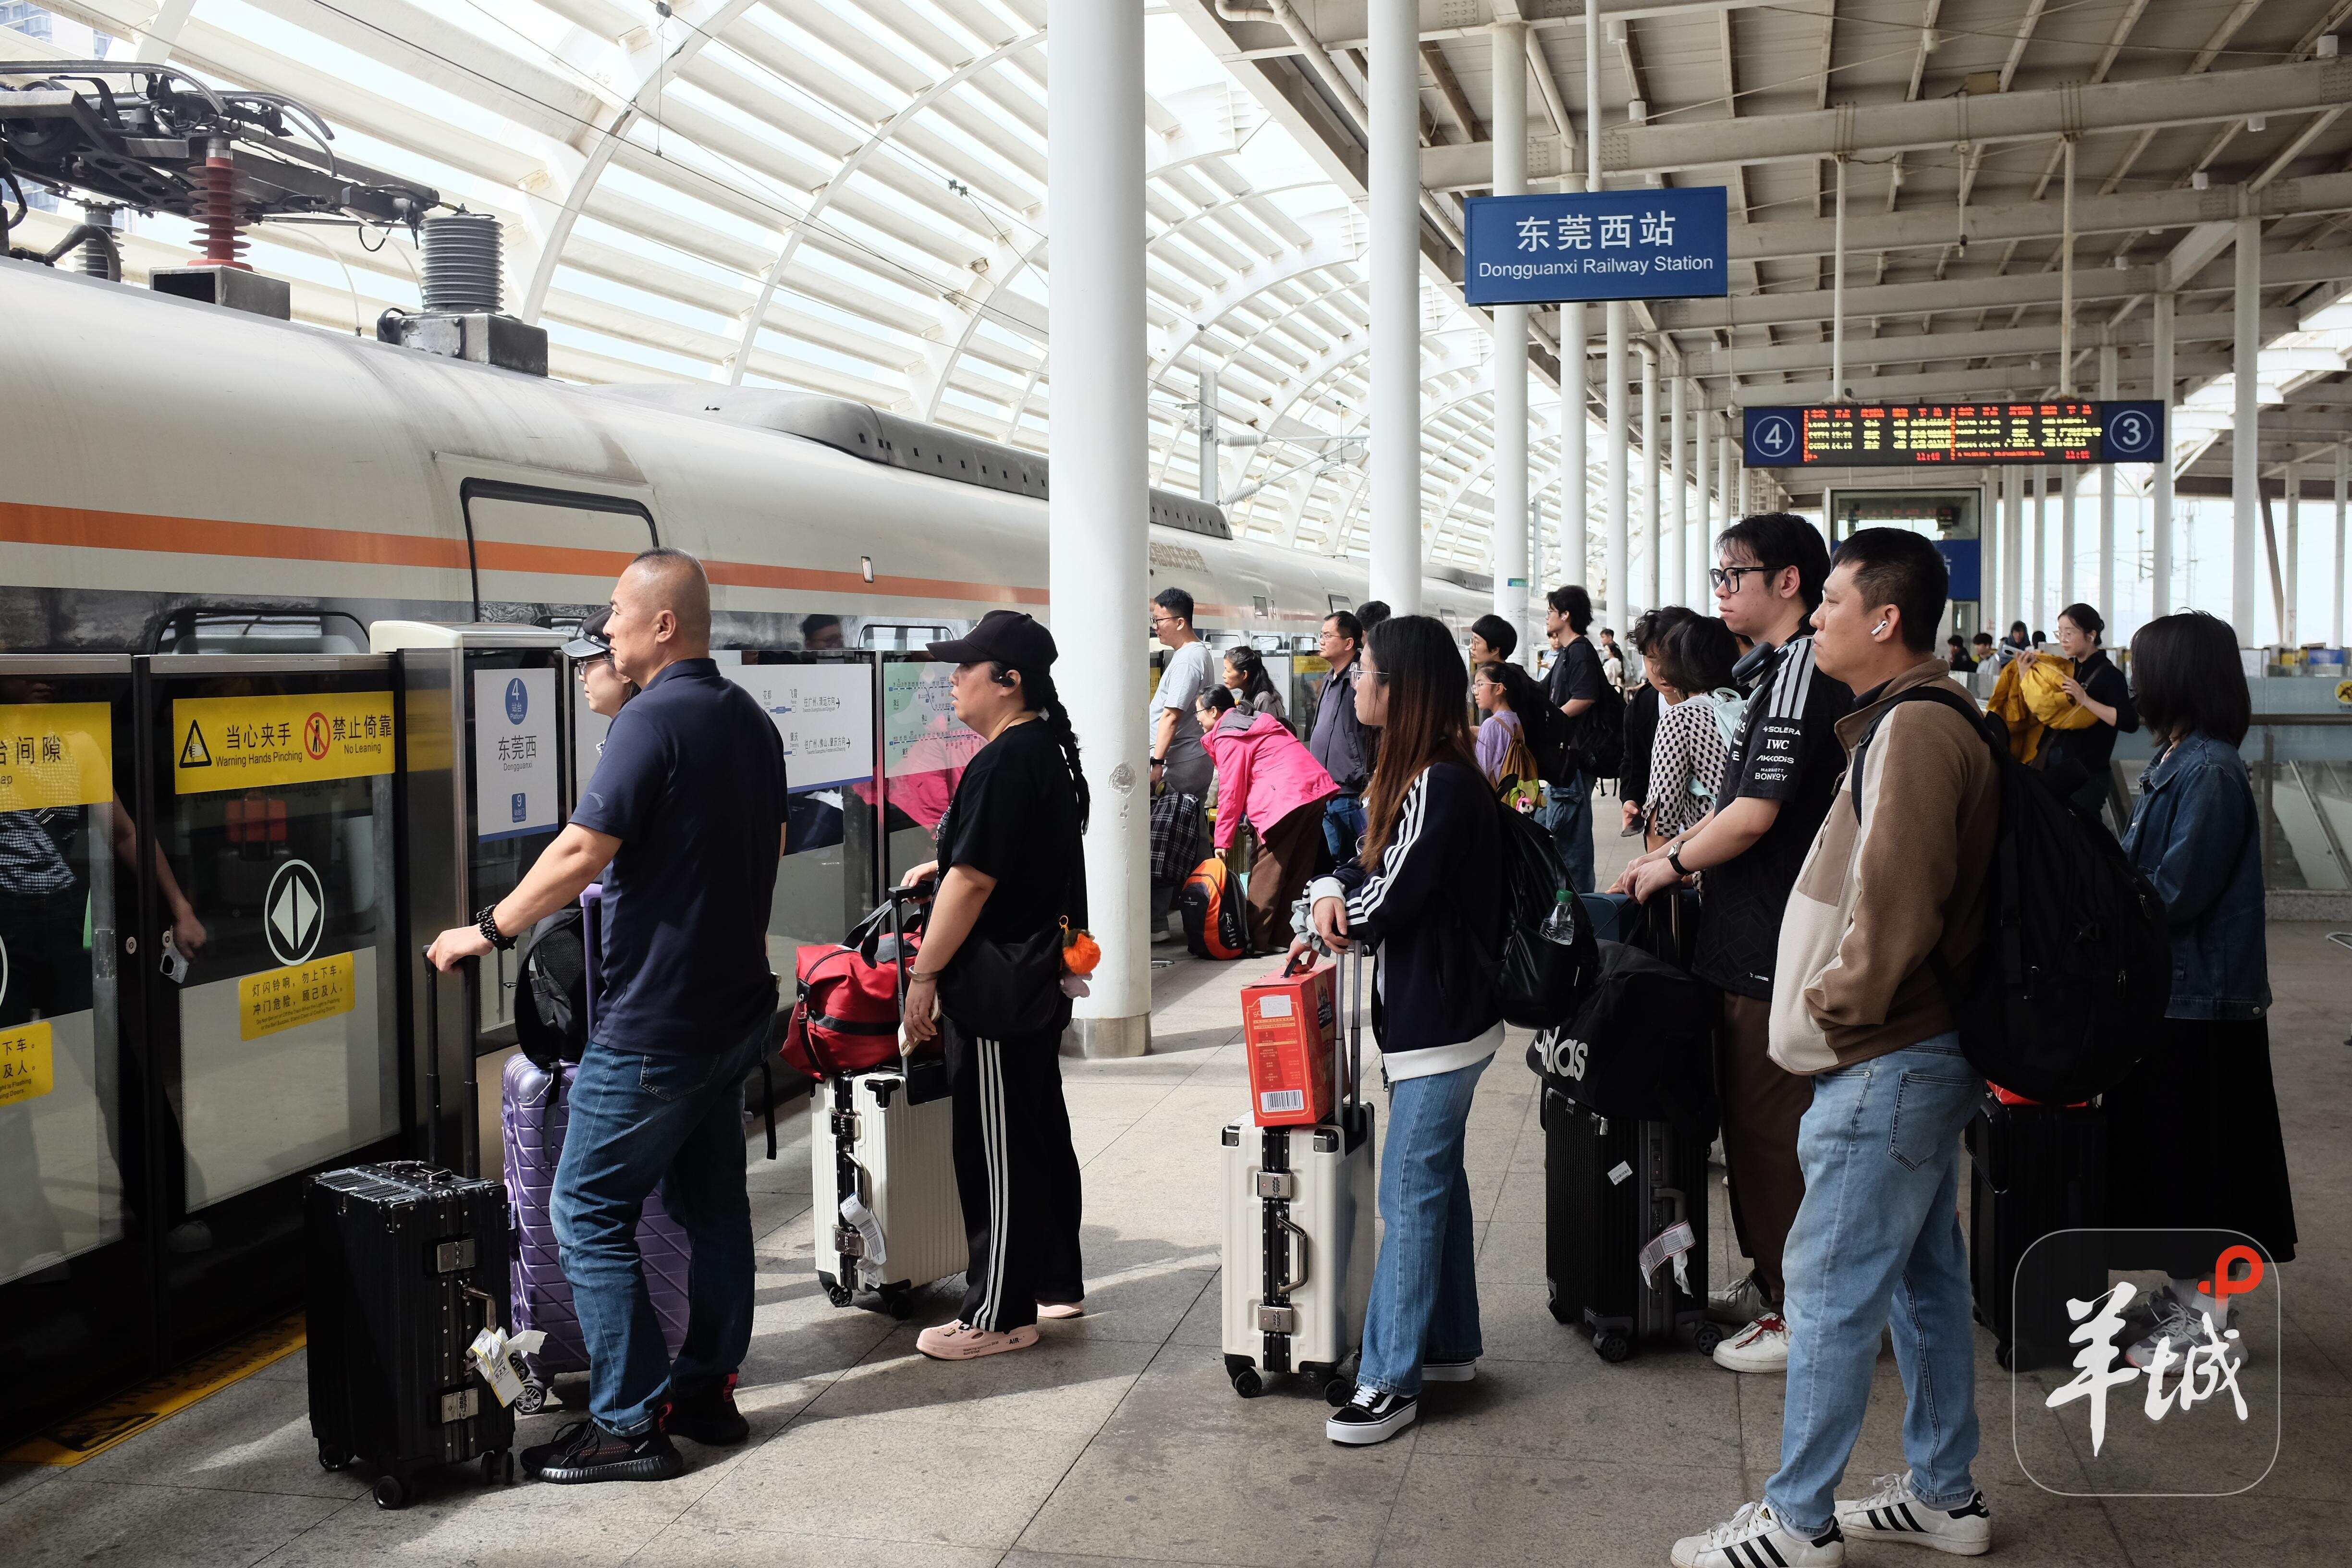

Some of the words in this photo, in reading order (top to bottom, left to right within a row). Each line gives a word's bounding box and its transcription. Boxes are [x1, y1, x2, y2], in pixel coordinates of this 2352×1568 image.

[1516, 210, 1676, 253] 东莞西站
[1479, 259, 1578, 280] Dongguanxi
[1583, 257, 1649, 275] Railway
[1654, 255, 1713, 272] Station
[1764, 423, 1784, 449] 4
[2121, 417, 2141, 445] 3
[512, 679, 520, 701] 4
[512, 702, 522, 712] 站台
[332, 713, 392, 742] 禁止倚靠
[1768, 726, 1801, 736] SOLERA
[227, 722, 292, 750] 当心夹手
[344, 744, 354, 755] No
[355, 743, 381, 754] Leaning
[498, 735, 537, 761] 东莞西
[1766, 739, 1790, 750] IWC
[216, 755, 246, 768] Warning
[248, 752, 272, 765] Hands
[273, 751, 303, 763] Pinching
[503, 761, 533, 772] Dongguanxi
[1754, 772, 1788, 781] BONVOY
[517, 795, 522, 807] 9
[12, 1078, 32, 1088] Flashing
[495, 1365, 507, 1379] SZX
